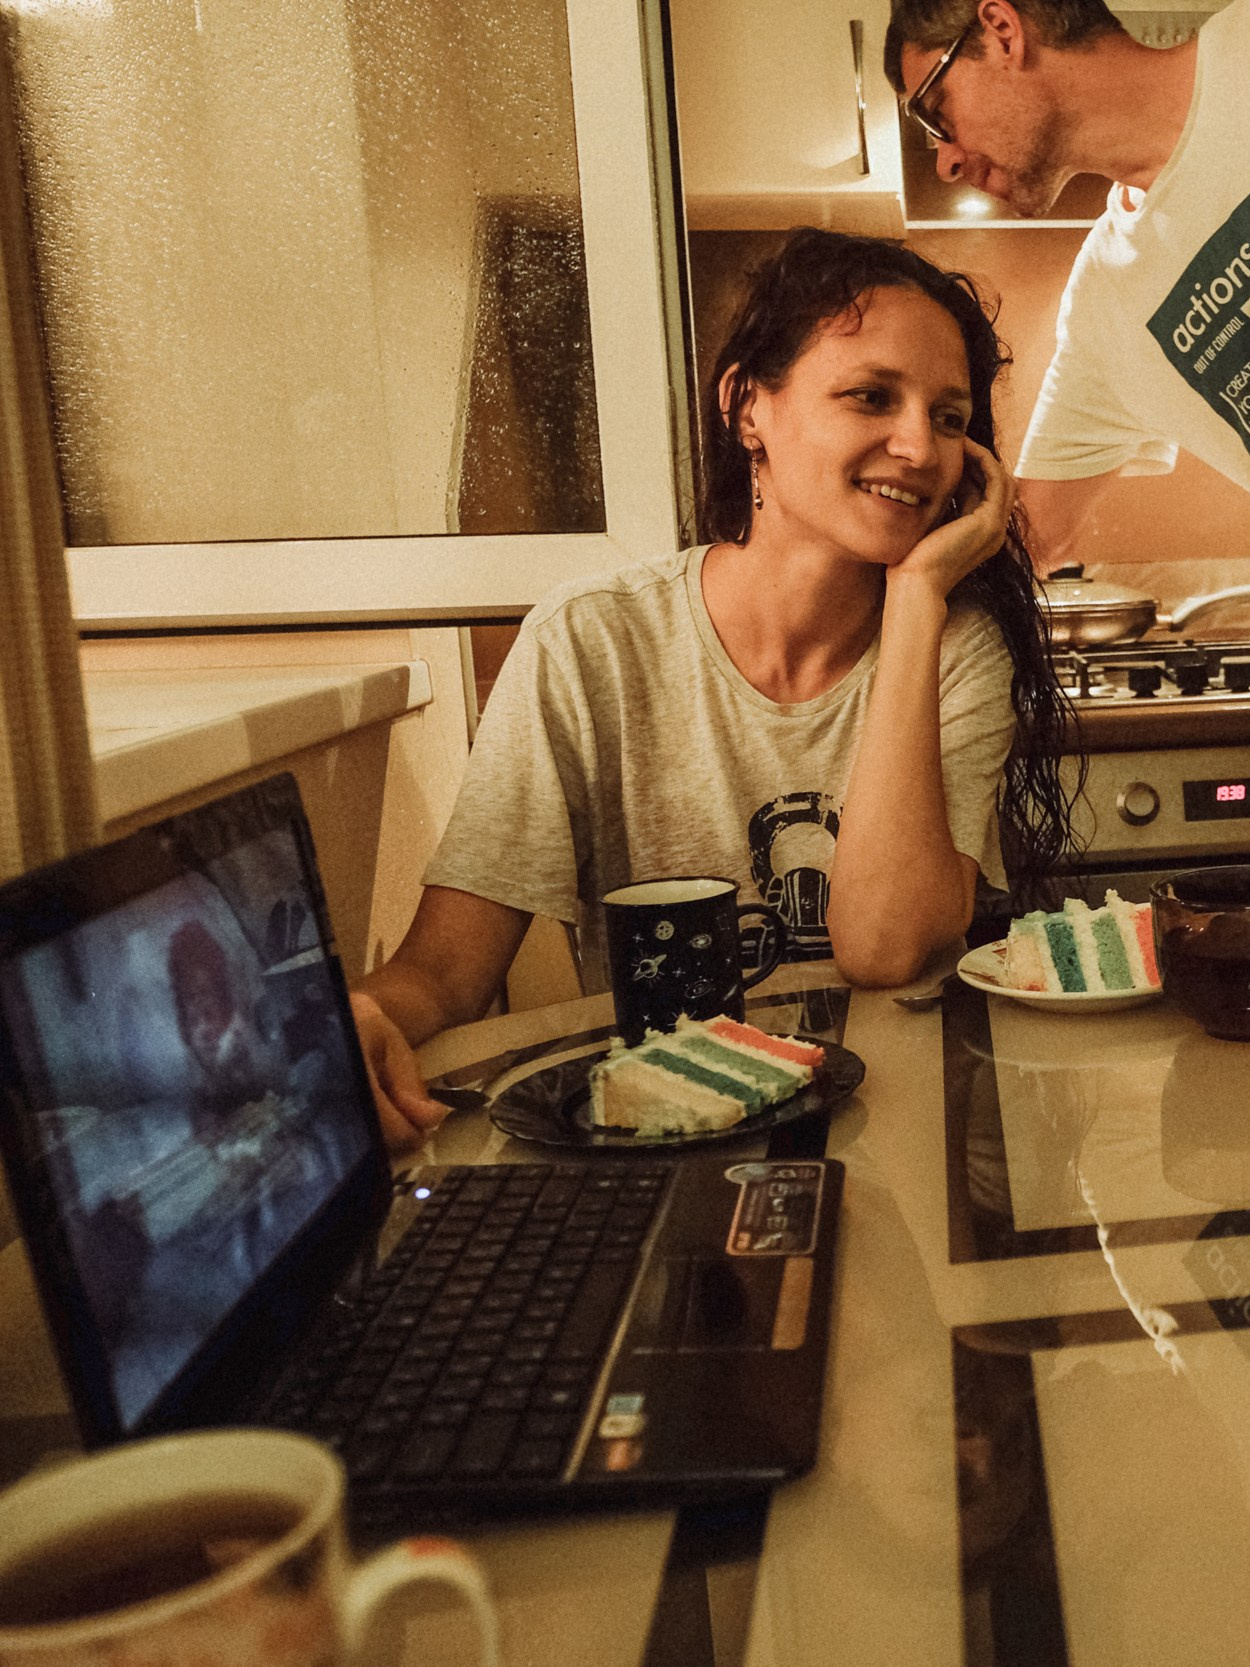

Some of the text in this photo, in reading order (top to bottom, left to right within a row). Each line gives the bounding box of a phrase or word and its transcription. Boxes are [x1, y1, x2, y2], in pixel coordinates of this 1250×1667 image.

[1193, 316, 1246, 375] OUT OF CONTROL
